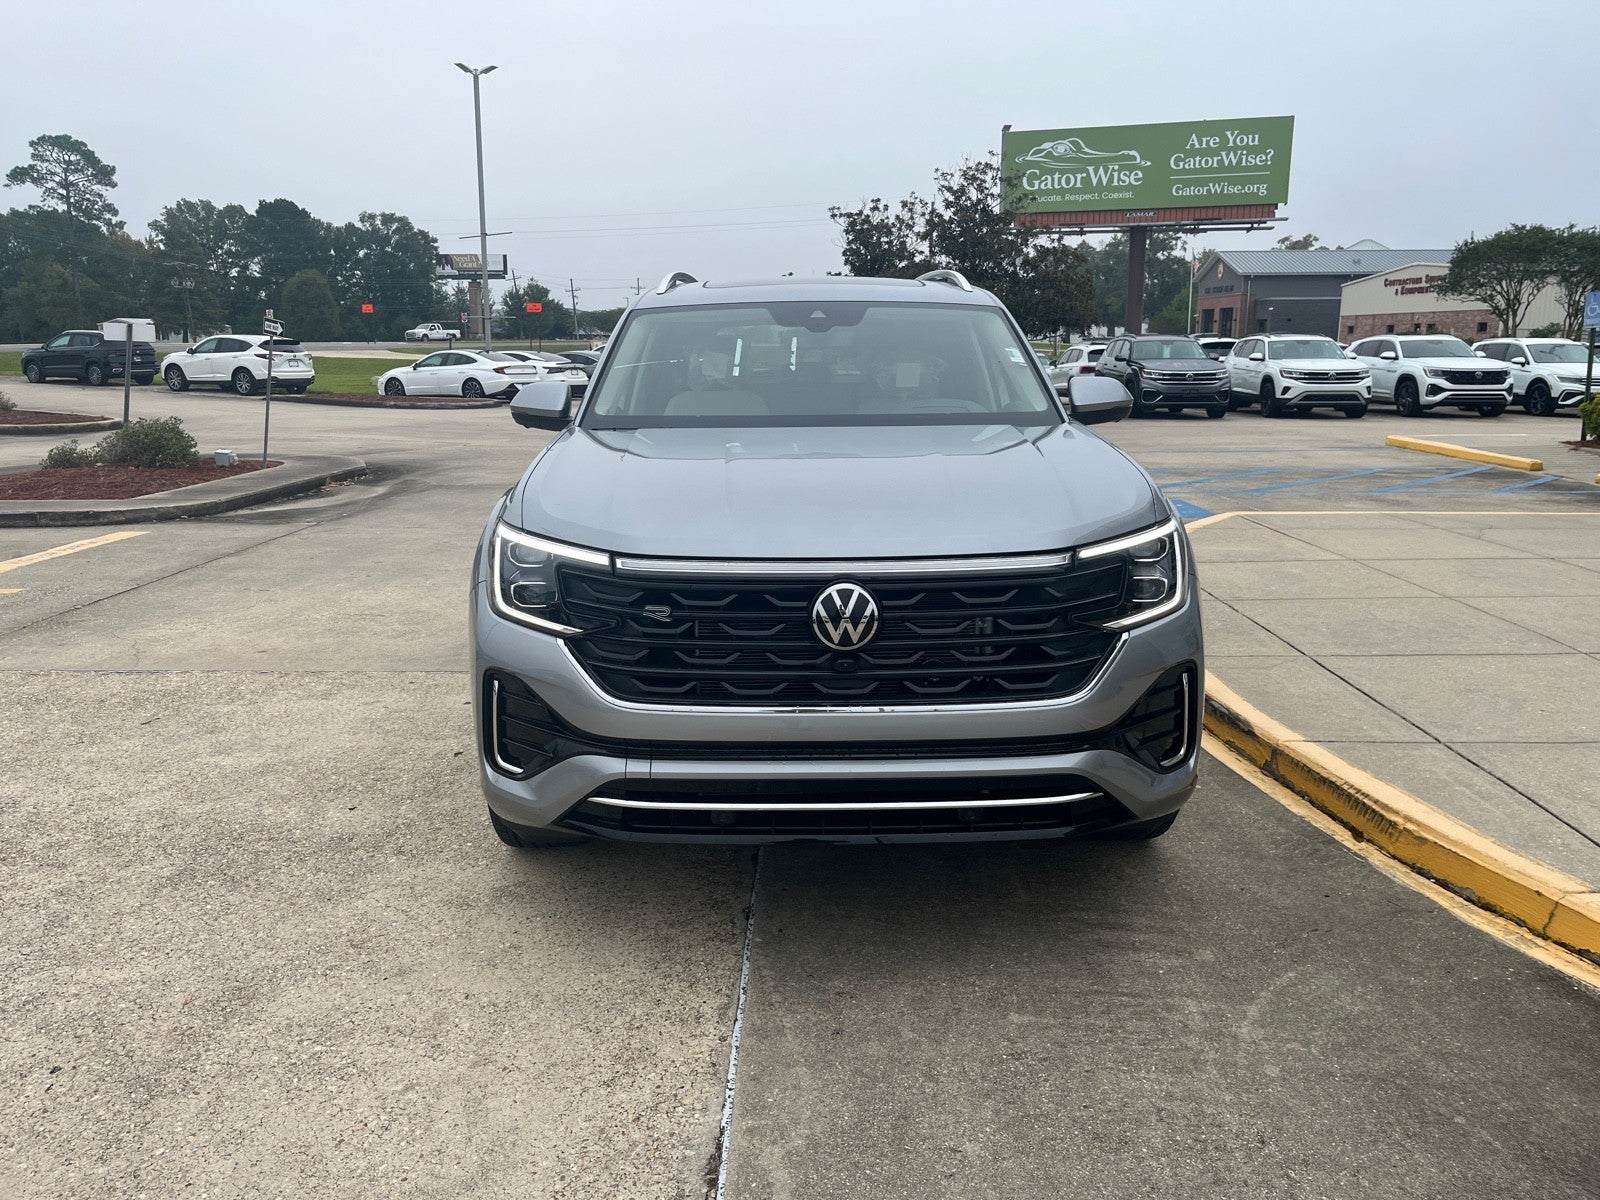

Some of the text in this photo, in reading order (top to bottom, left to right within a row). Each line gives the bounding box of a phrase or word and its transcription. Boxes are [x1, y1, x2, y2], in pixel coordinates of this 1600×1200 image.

[1185, 130, 1259, 149] Are You
[1170, 149, 1275, 170] GatorWise?
[1028, 191, 1134, 203] ucate. Respect. Coexist.
[1172, 182, 1268, 196] GatorWise.org
